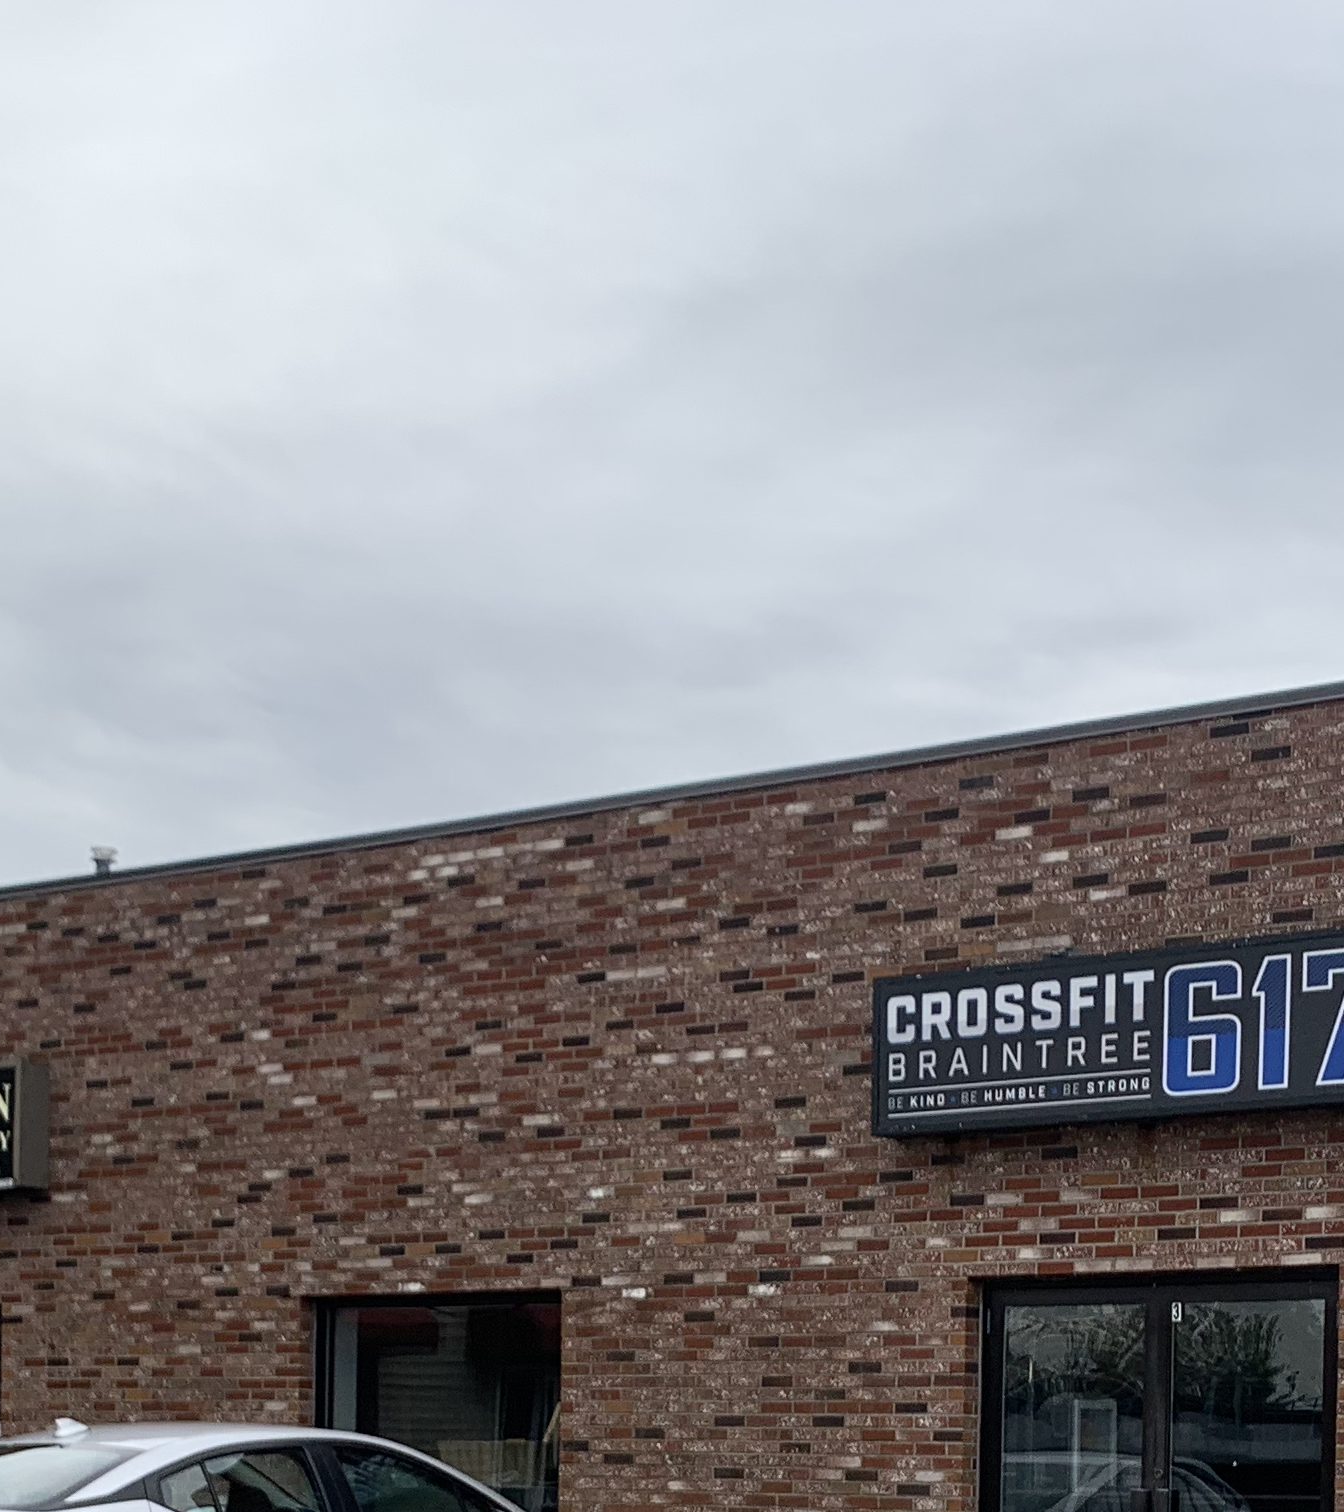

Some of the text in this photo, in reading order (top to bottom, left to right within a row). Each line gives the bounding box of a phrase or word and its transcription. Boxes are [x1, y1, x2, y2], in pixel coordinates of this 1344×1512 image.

[887, 969, 1155, 1044] CROSSFIT
[888, 1030, 1151, 1082] BRAINTREE
[888, 1077, 1150, 1110] BE KIND BE HUMBLE BE STRONG
